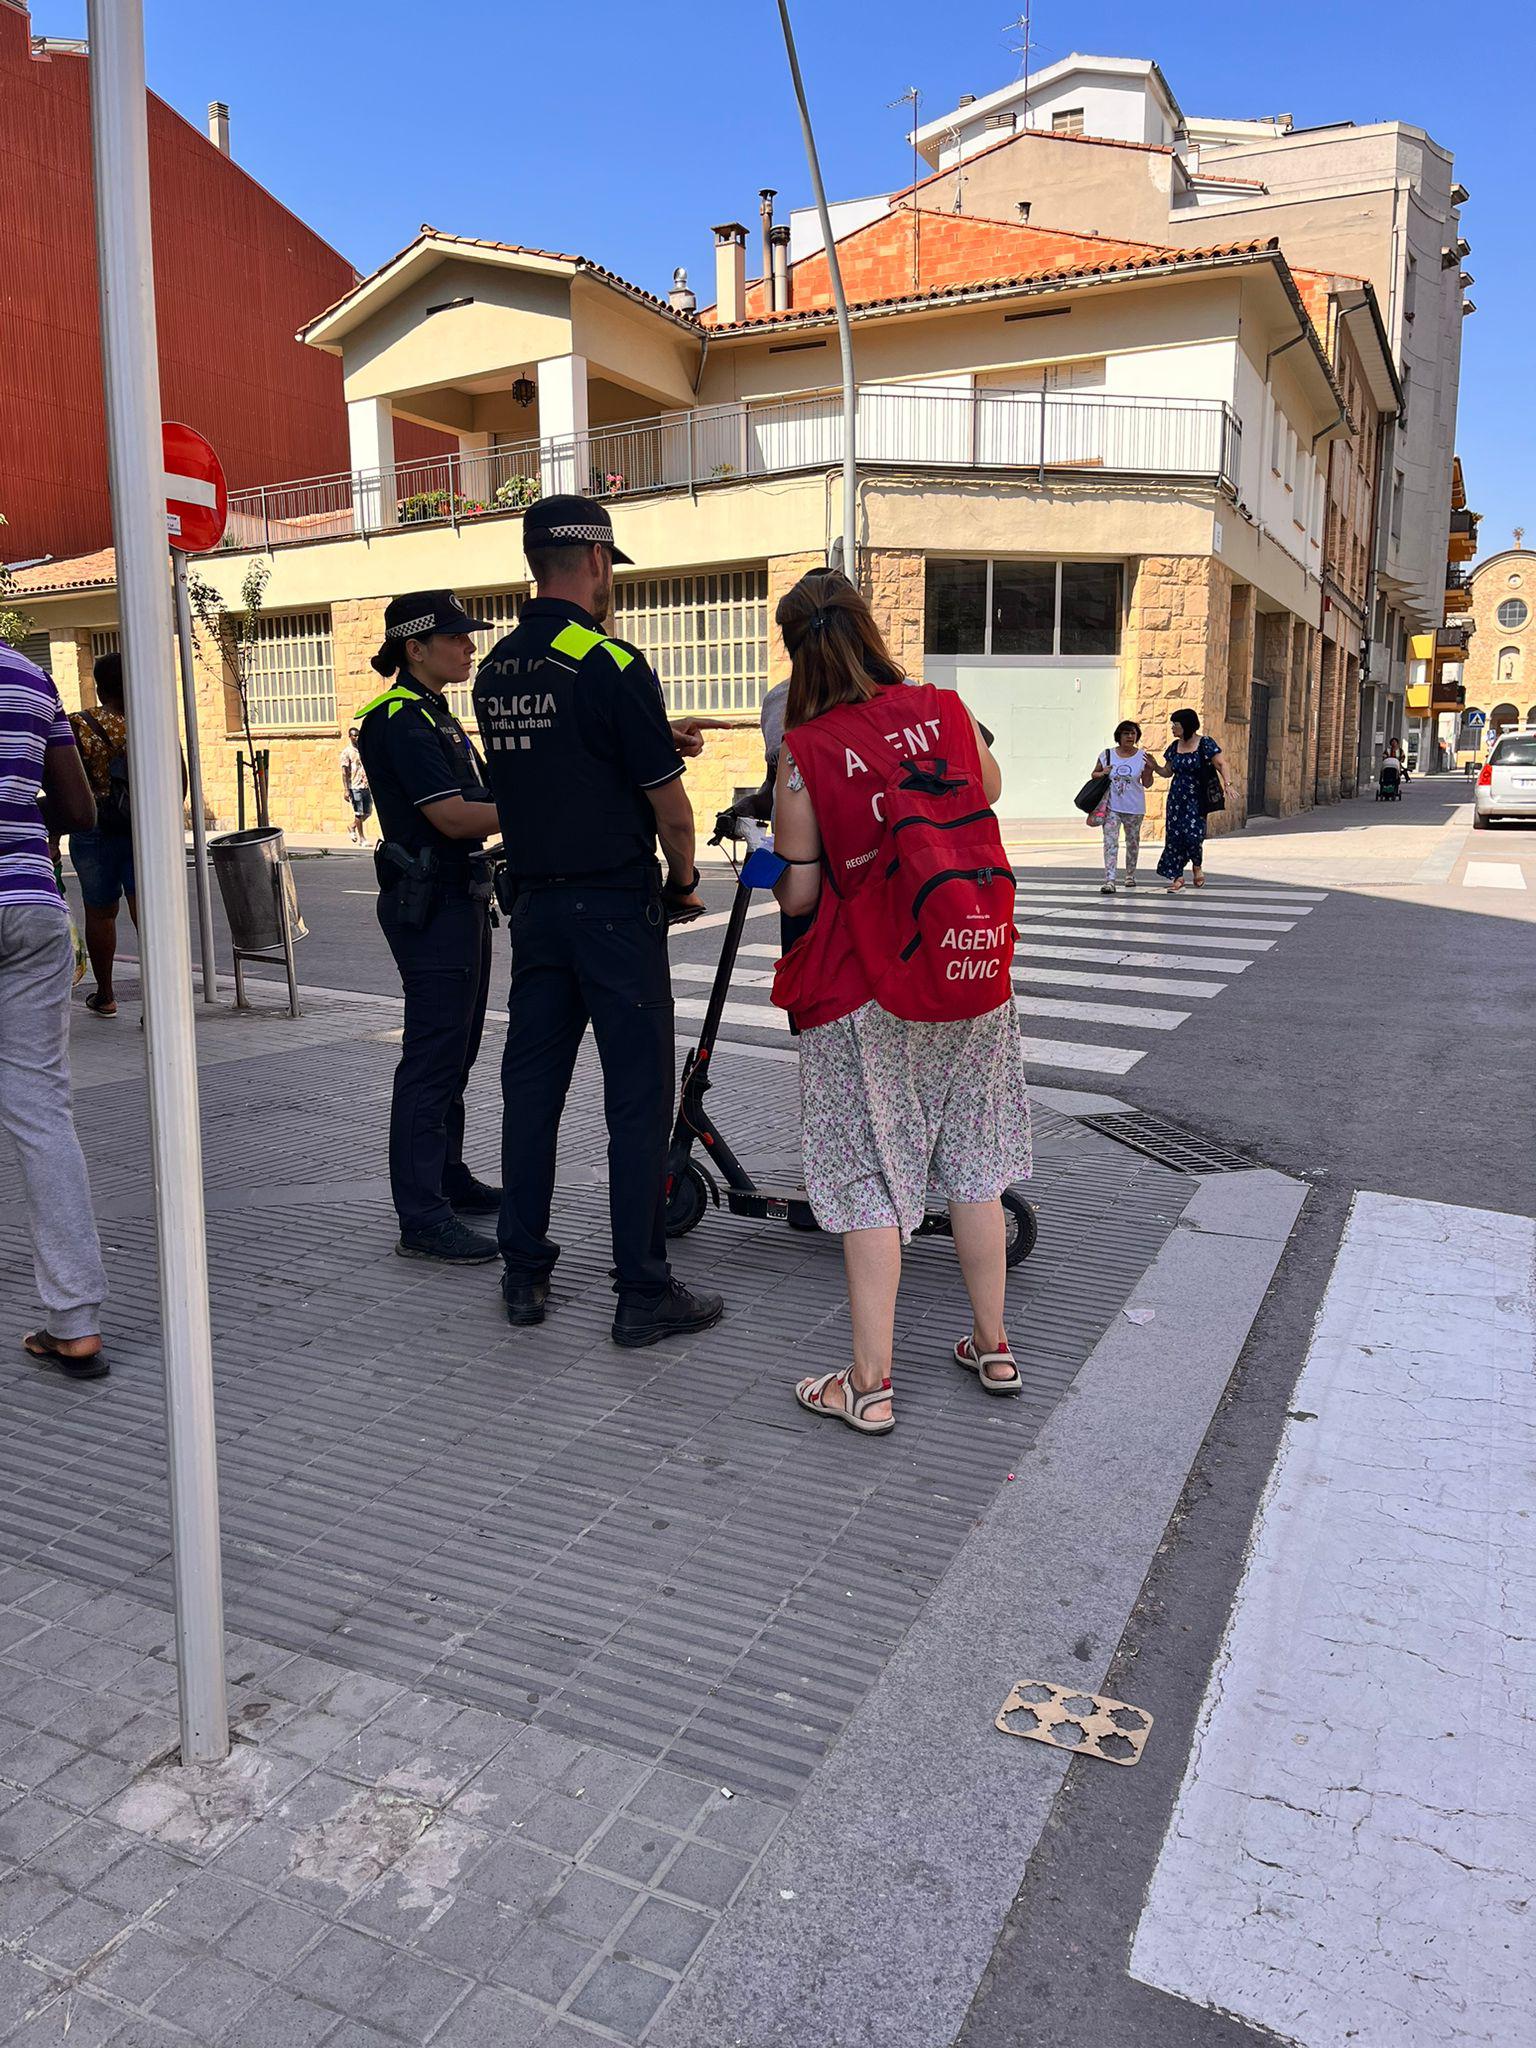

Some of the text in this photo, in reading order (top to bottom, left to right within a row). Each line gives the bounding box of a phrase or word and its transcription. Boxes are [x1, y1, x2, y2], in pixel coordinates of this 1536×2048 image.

[478, 693, 557, 717] OLICIA
[844, 718, 941, 778] AENT
[940, 922, 1008, 950] AGENT
[946, 956, 1000, 980] CÍVIC
